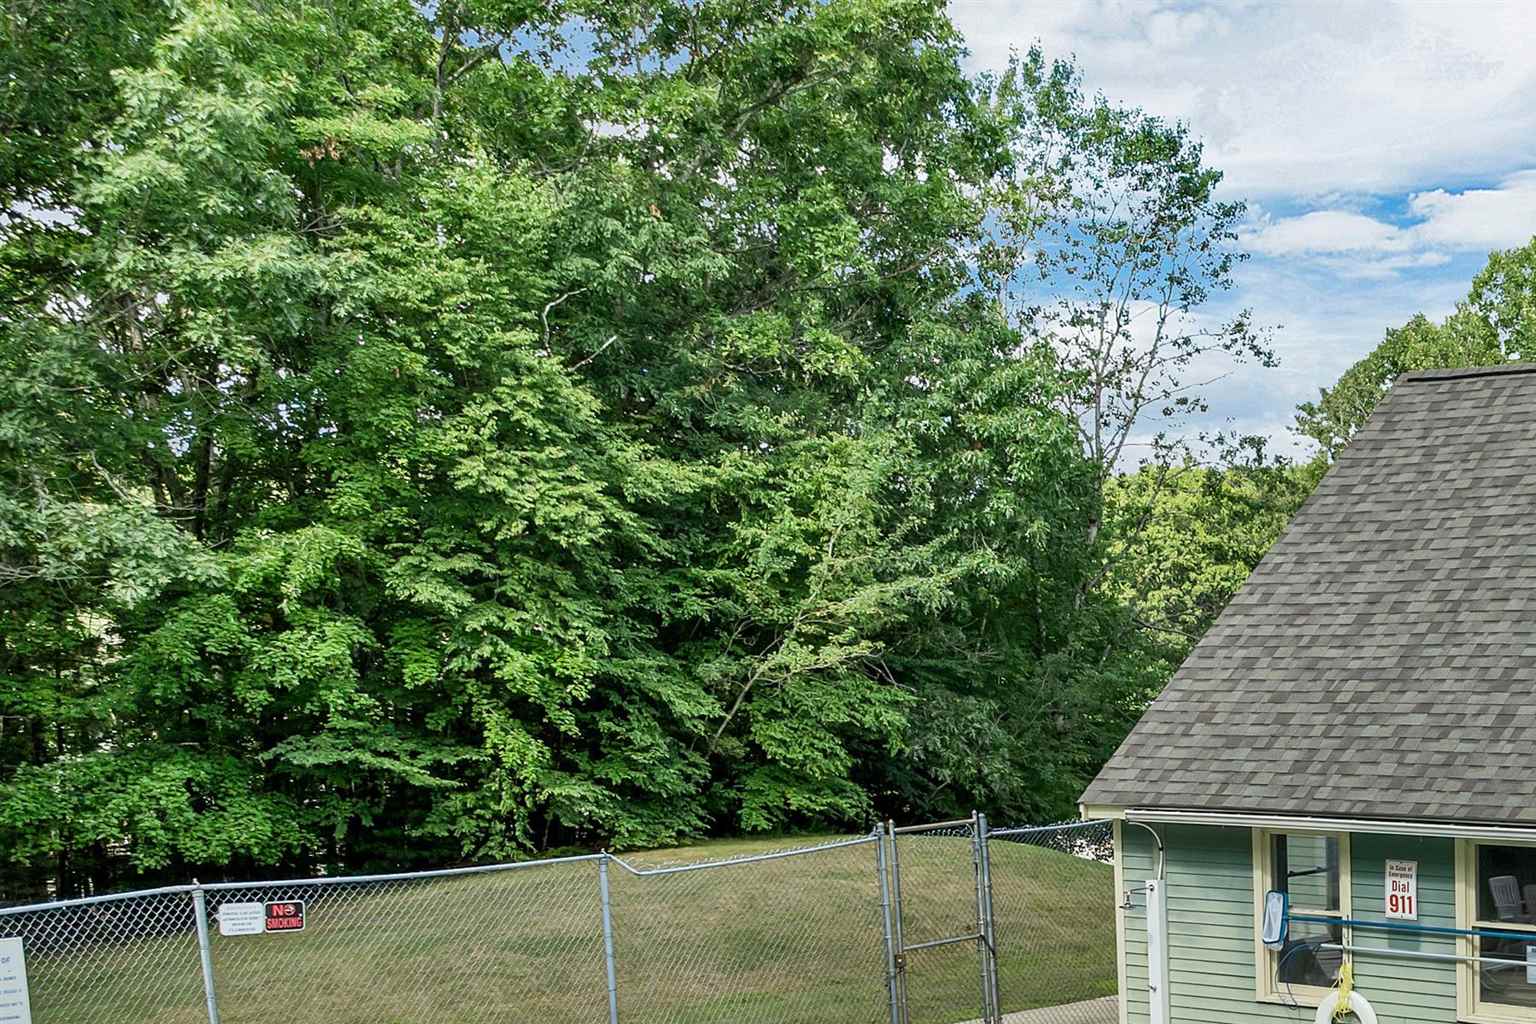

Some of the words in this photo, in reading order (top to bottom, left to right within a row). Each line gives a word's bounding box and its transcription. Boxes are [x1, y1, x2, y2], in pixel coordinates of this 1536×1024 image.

[1391, 880, 1410, 893] Dial
[271, 903, 296, 917] NO
[1389, 894, 1413, 914] 911
[267, 916, 303, 929] SMOKING
